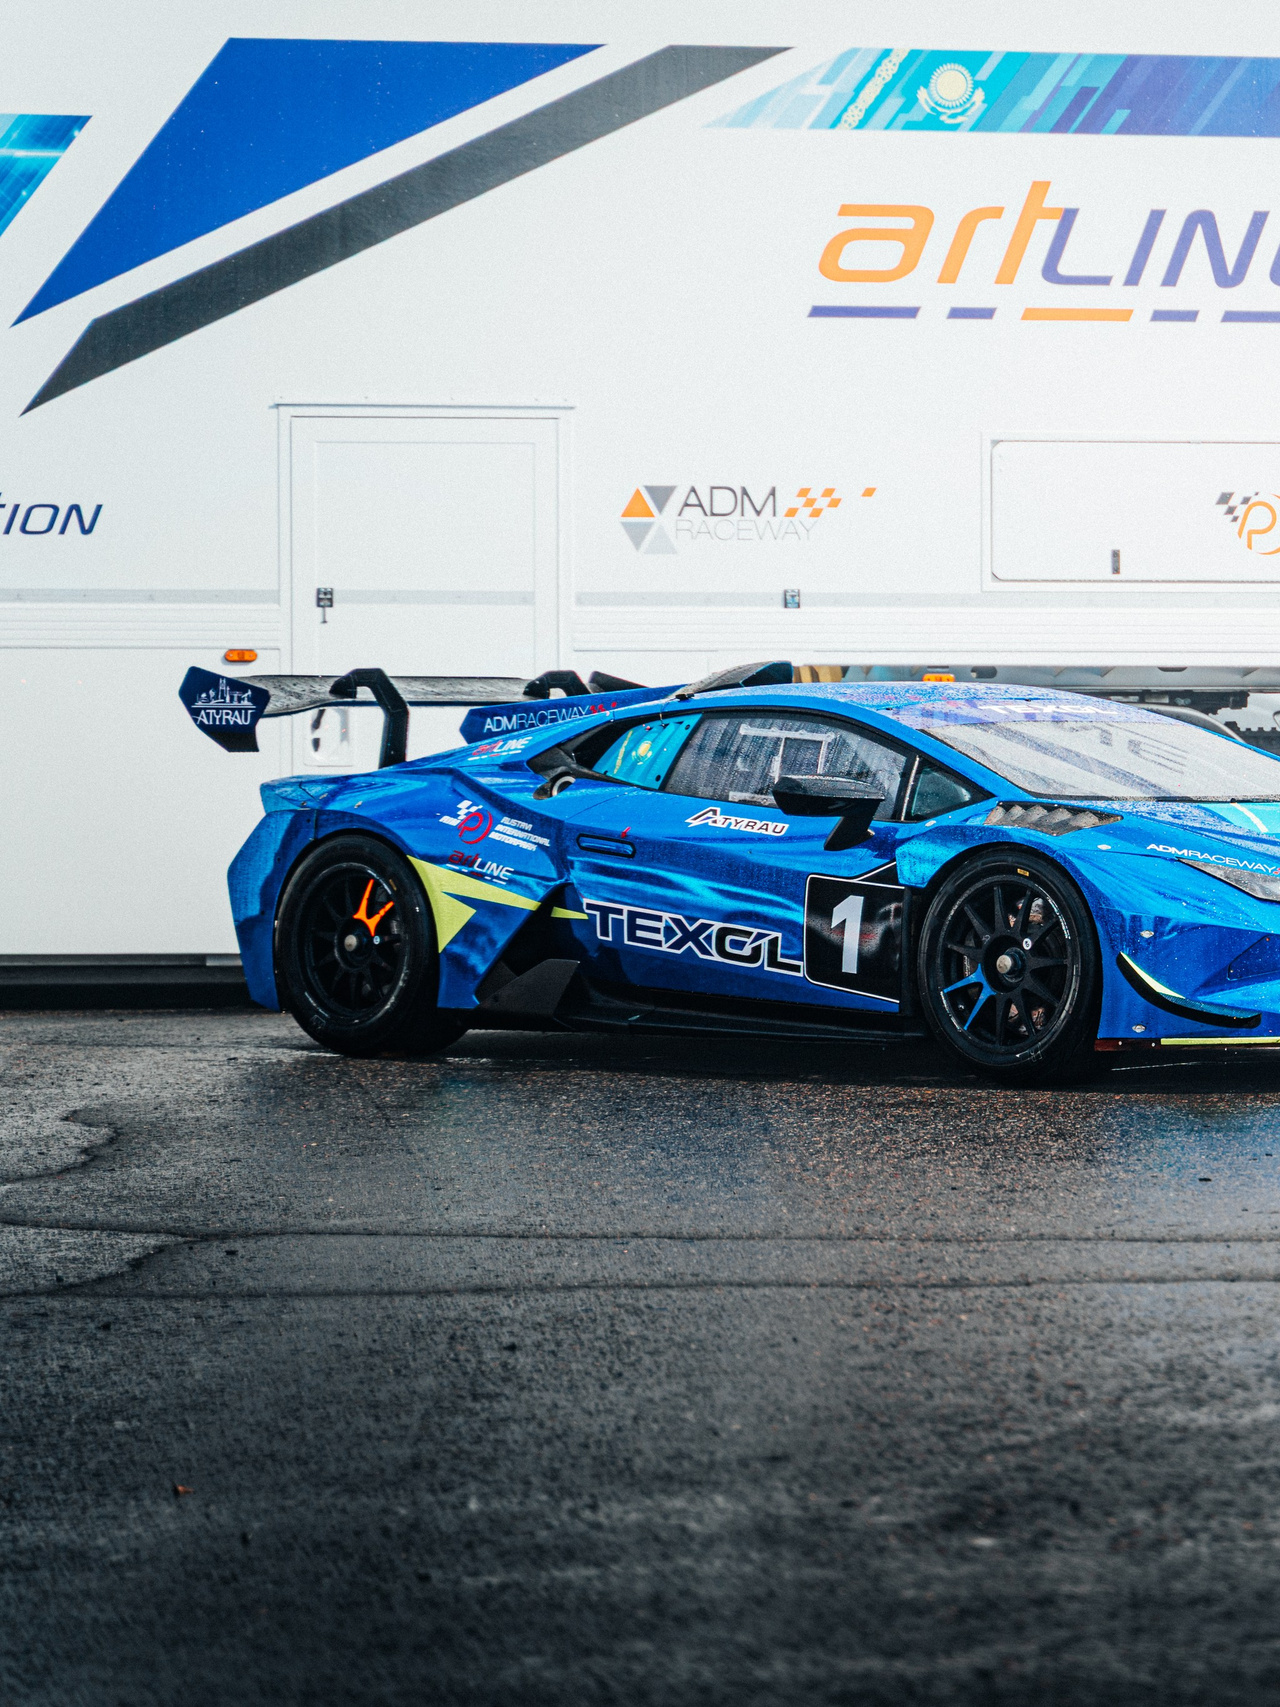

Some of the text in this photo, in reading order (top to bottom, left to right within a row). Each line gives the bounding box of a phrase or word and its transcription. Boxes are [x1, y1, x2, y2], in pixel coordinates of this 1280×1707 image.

[0, 492, 103, 536] ION
[677, 486, 776, 517] ADM
[675, 519, 818, 541] RACEWAY
[192, 709, 256, 725] ATYRAU
[495, 824, 550, 847] INTERNATIONAL
[685, 806, 789, 836] ATYRAU
[830, 894, 865, 975] 1
